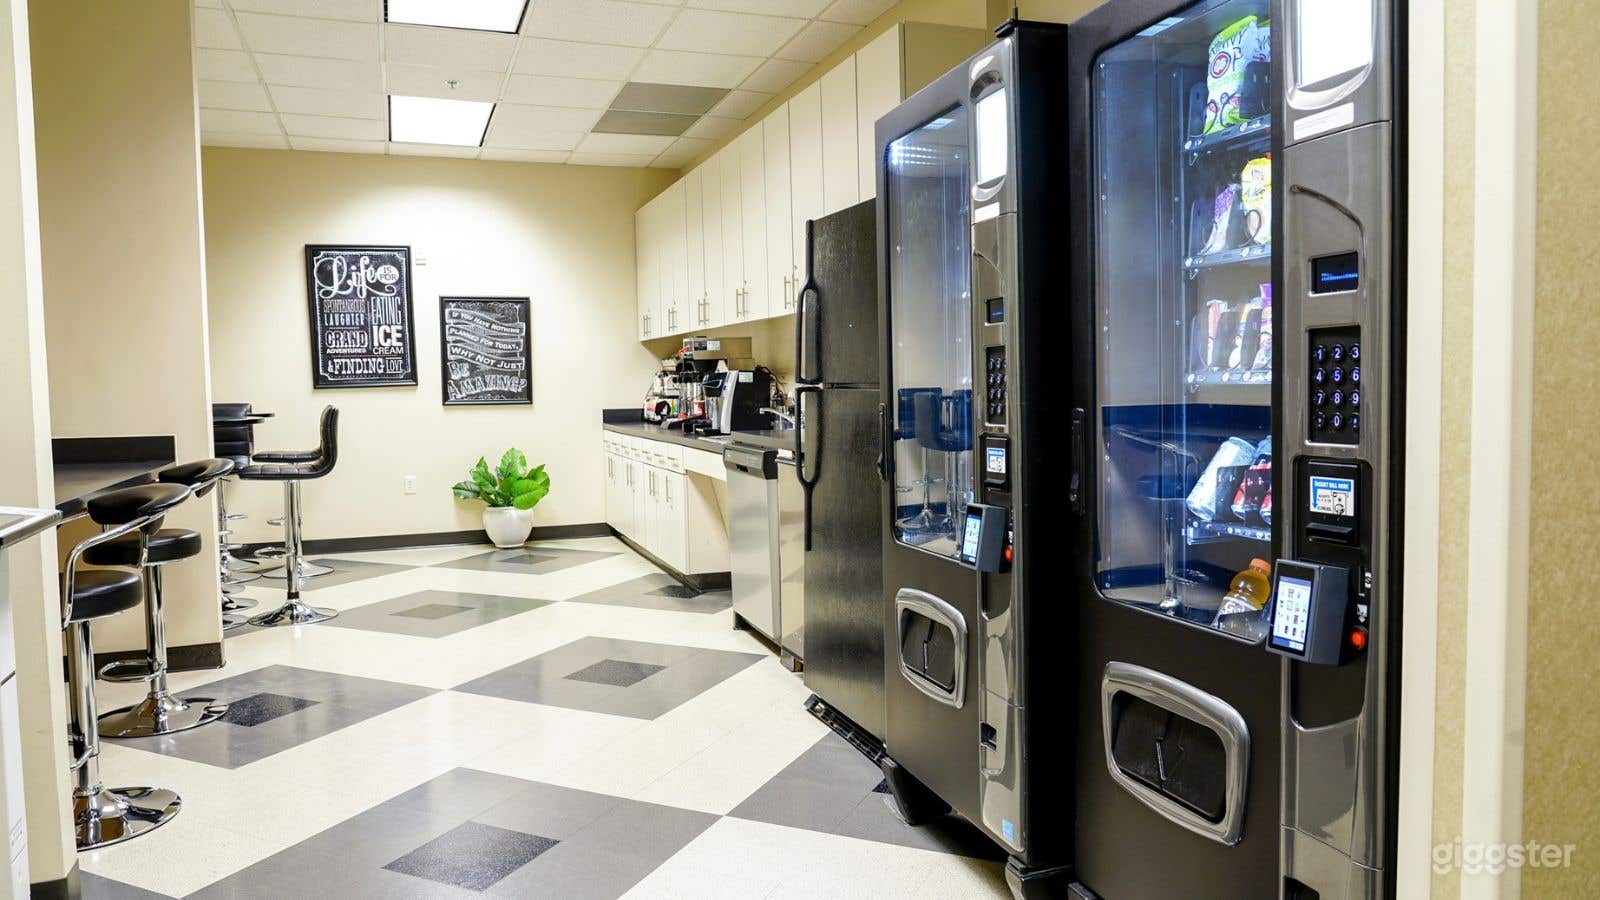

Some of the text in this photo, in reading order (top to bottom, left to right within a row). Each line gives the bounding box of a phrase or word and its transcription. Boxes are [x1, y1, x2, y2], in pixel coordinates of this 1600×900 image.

[314, 256, 380, 298] Life
[380, 273, 397, 281] FOR
[383, 266, 392, 274] IS
[371, 296, 402, 325] EATING
[324, 312, 365, 326] LAUGHTER
[460, 312, 474, 321] YOU
[474, 317, 491, 328] HAVE
[490, 324, 521, 334] NOTHING
[325, 330, 368, 348] GRAND
[372, 325, 403, 347] ICE
[449, 327, 480, 341] PLANNED
[480, 338, 494, 347] FOR
[372, 346, 404, 355] CREAM
[451, 346, 475, 358] WHY
[475, 354, 497, 366] NOT
[1316, 347, 1359, 360] 1 2 3
[1316, 369, 1360, 382] 4 5 6
[447, 375, 528, 401] AMAZING?
[1317, 392, 1360, 404] 7 8 9
[1333, 415, 1340, 427] 0
